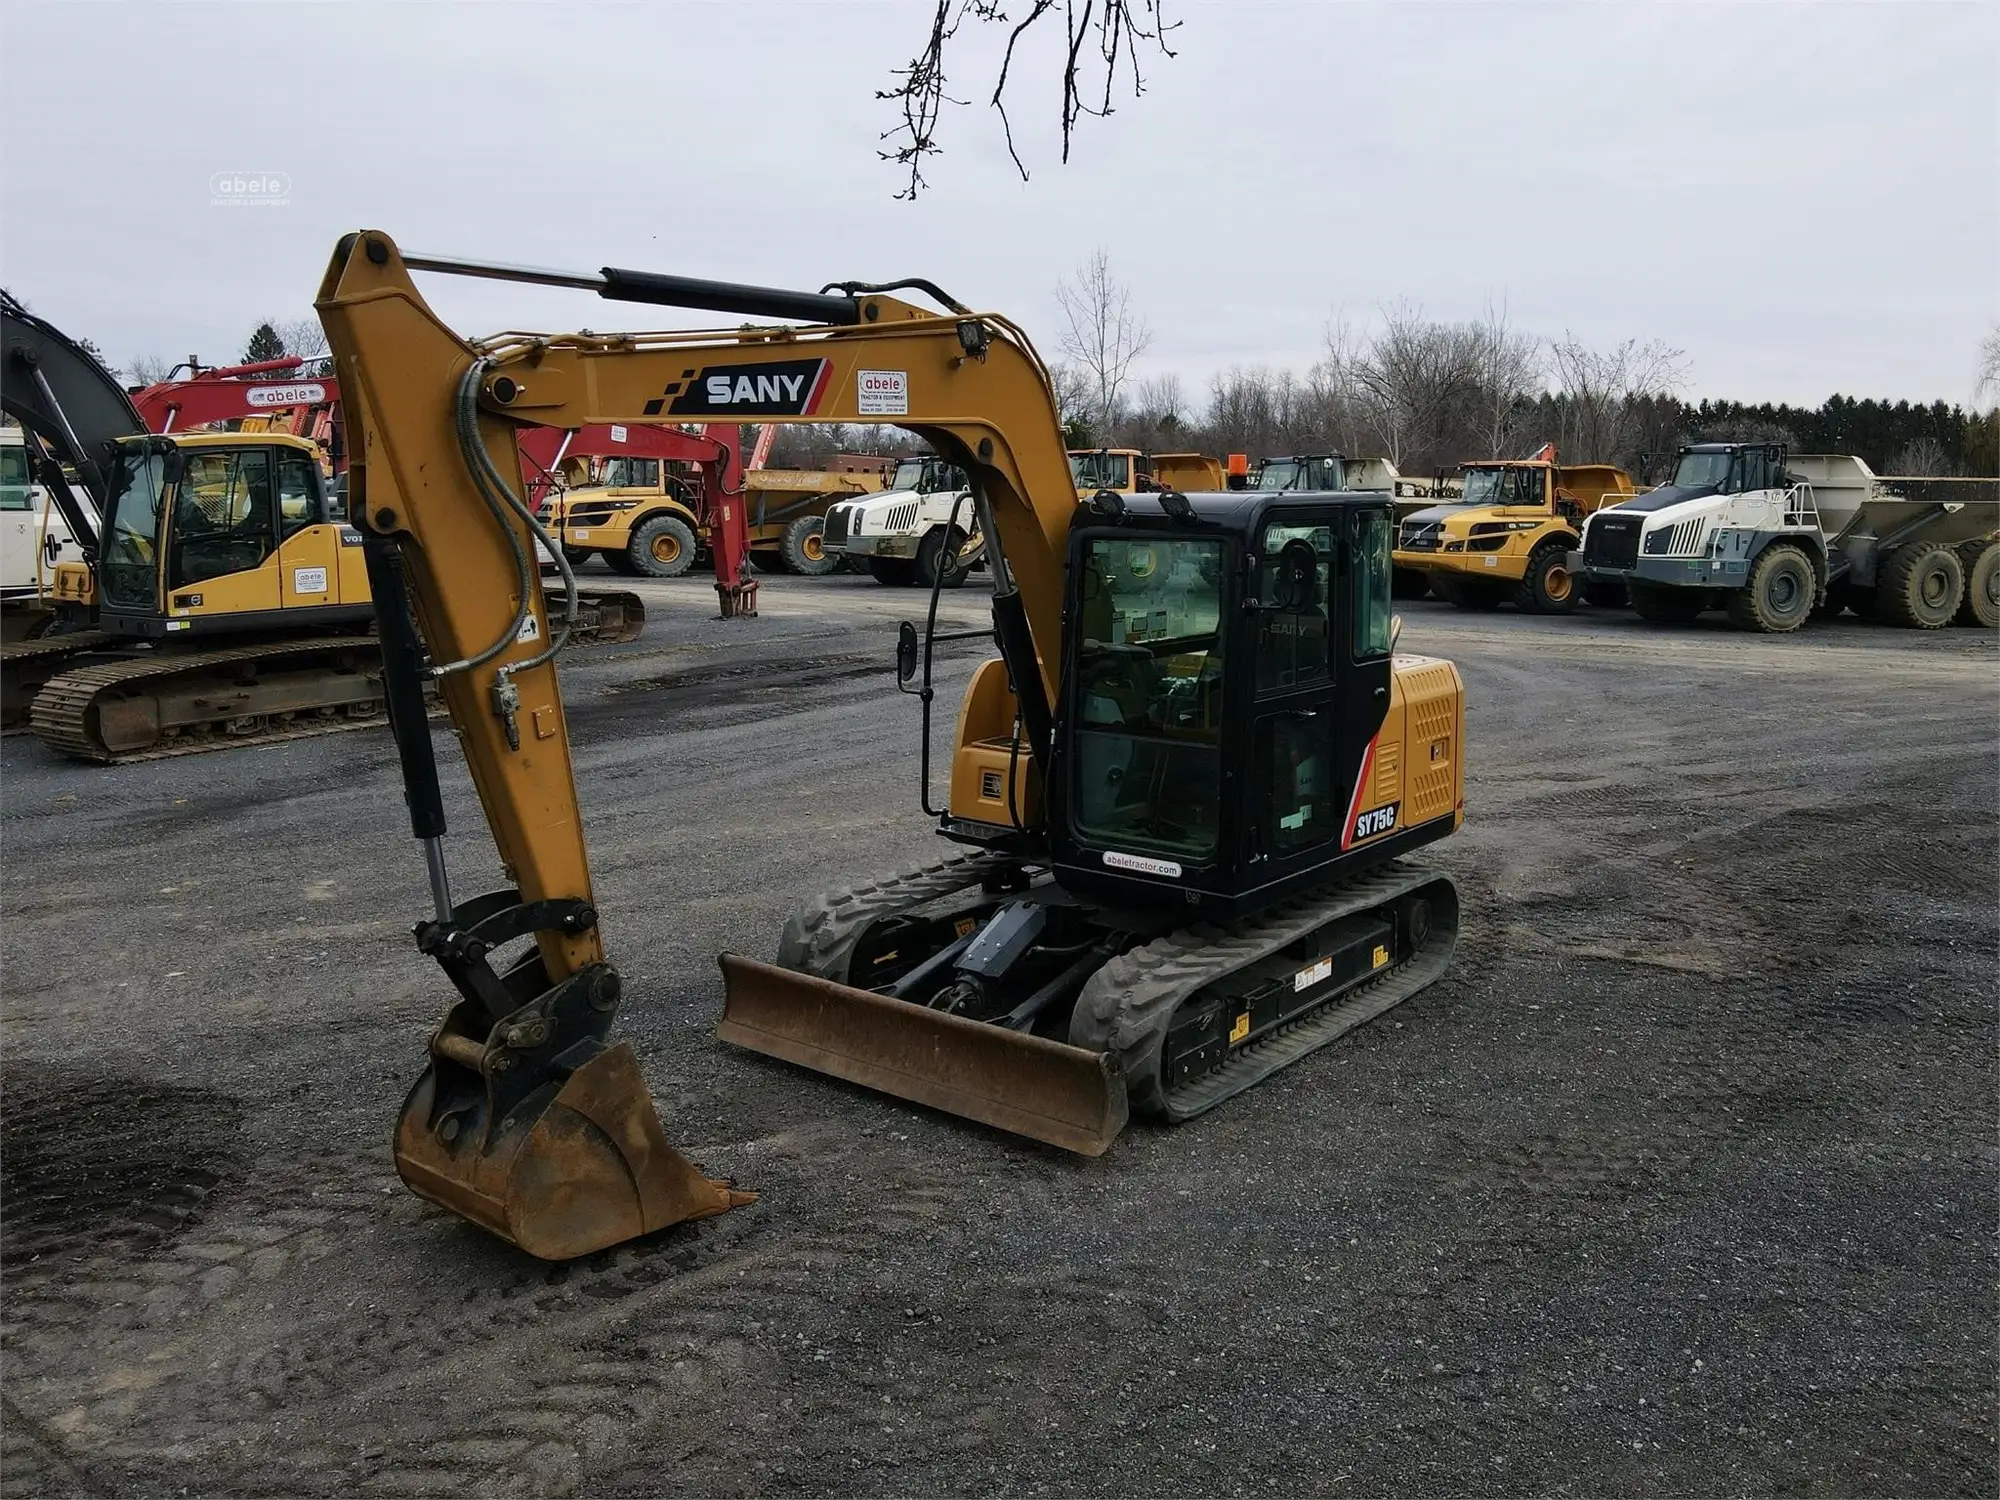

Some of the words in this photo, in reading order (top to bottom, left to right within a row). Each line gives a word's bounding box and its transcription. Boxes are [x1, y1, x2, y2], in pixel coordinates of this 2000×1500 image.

[706, 374, 805, 404] SANY
[865, 377, 900, 390] abele
[267, 389, 307, 402] abele
[1357, 806, 1395, 837] SY75C
[1106, 855, 1178, 876] abeletractor.com
